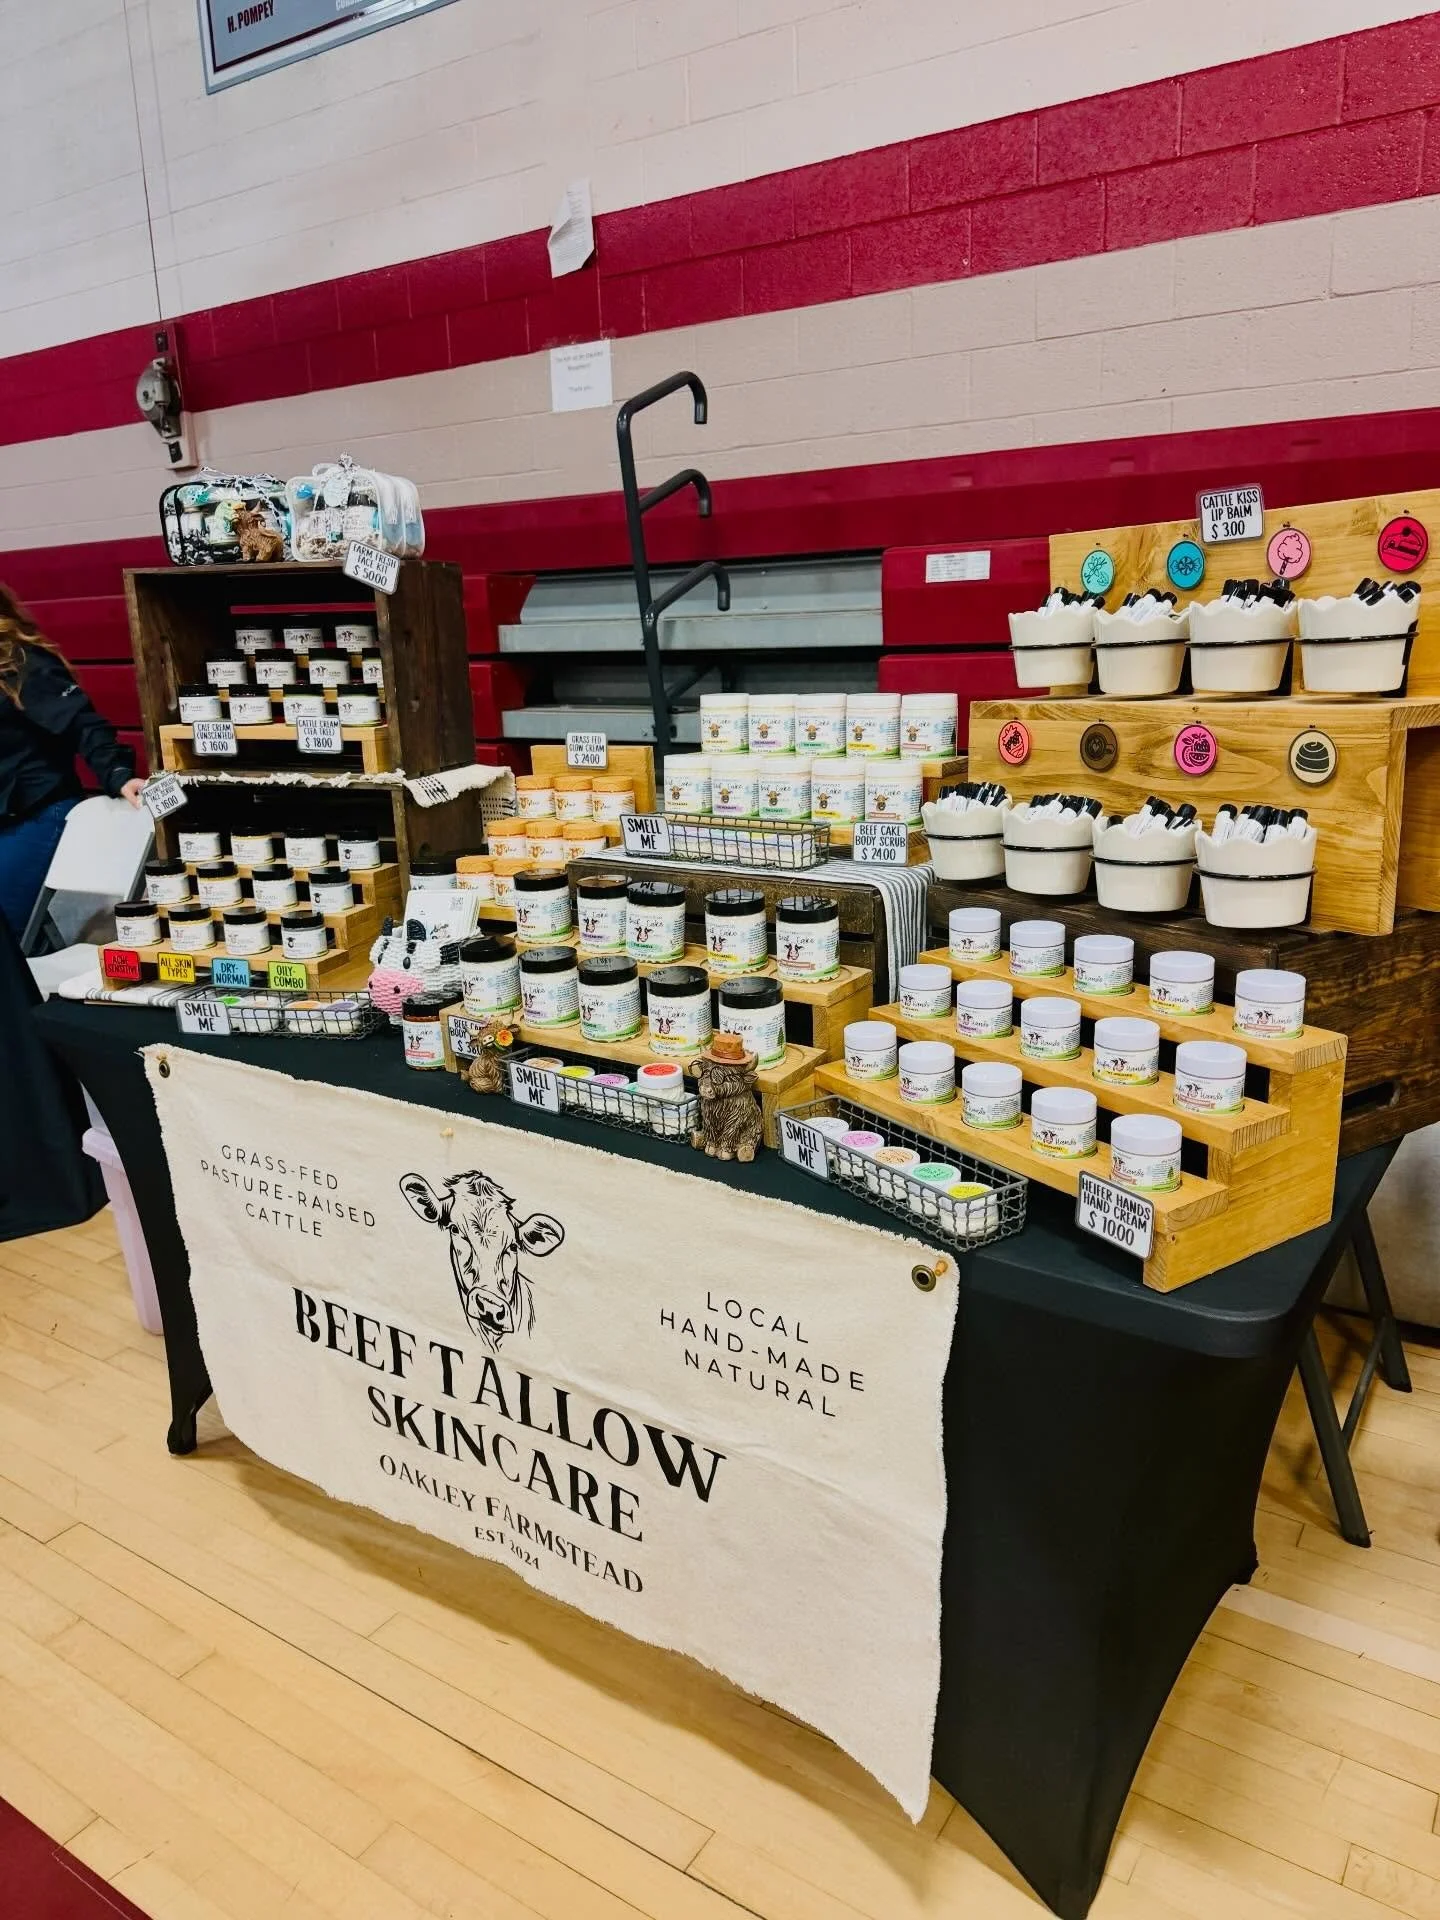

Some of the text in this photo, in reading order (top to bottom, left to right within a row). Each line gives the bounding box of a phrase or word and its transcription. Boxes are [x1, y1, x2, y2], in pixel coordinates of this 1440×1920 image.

[227, 0, 274, 34] H. POMPEY
[1202, 490, 1258, 510] CATTLE KISS
[1211, 504, 1252, 521] LIP BALM
[1211, 520, 1245, 540] $ 3.00
[628, 818, 662, 835] SMELL
[860, 825, 901, 837] BEEF CAKE
[640, 834, 657, 849] ME
[855, 835, 906, 848] BODY SCRUB
[861, 847, 868, 861] $
[160, 957, 192, 970] ALL SKIN
[167, 967, 193, 978] TYPES
[220, 962, 239, 974] DRY-
[214, 972, 248, 986] NORMAL
[273, 974, 303, 989] COMBO
[183, 1002, 220, 1018] SMELL
[199, 1017, 216, 1032] ME
[515, 1066, 552, 1091] SMELL
[529, 1086, 546, 1107] ME
[785, 1120, 820, 1153] SMELL
[221, 1144, 338, 1190] GRASS-FED
[798, 1143, 815, 1170] ME
[200, 1159, 375, 1228] PASTURE-RAISED
[1081, 1177, 1152, 1221] HEIFER HANDS
[245, 1202, 323, 1238] CATTLE
[1083, 1190, 1147, 1233] HAND CREAM
[1087, 1210, 1135, 1247] $ 10.00
[706, 1291, 808, 1344] LOCAL
[660, 1308, 865, 1392] HAND-MADE
[684, 1349, 836, 1417] NATURAL
[367, 1385, 643, 1543] SKINCARE
[379, 1454, 643, 1594] OAKLEY FARMSTEAD
[475, 1526, 541, 1570] EST 2024
